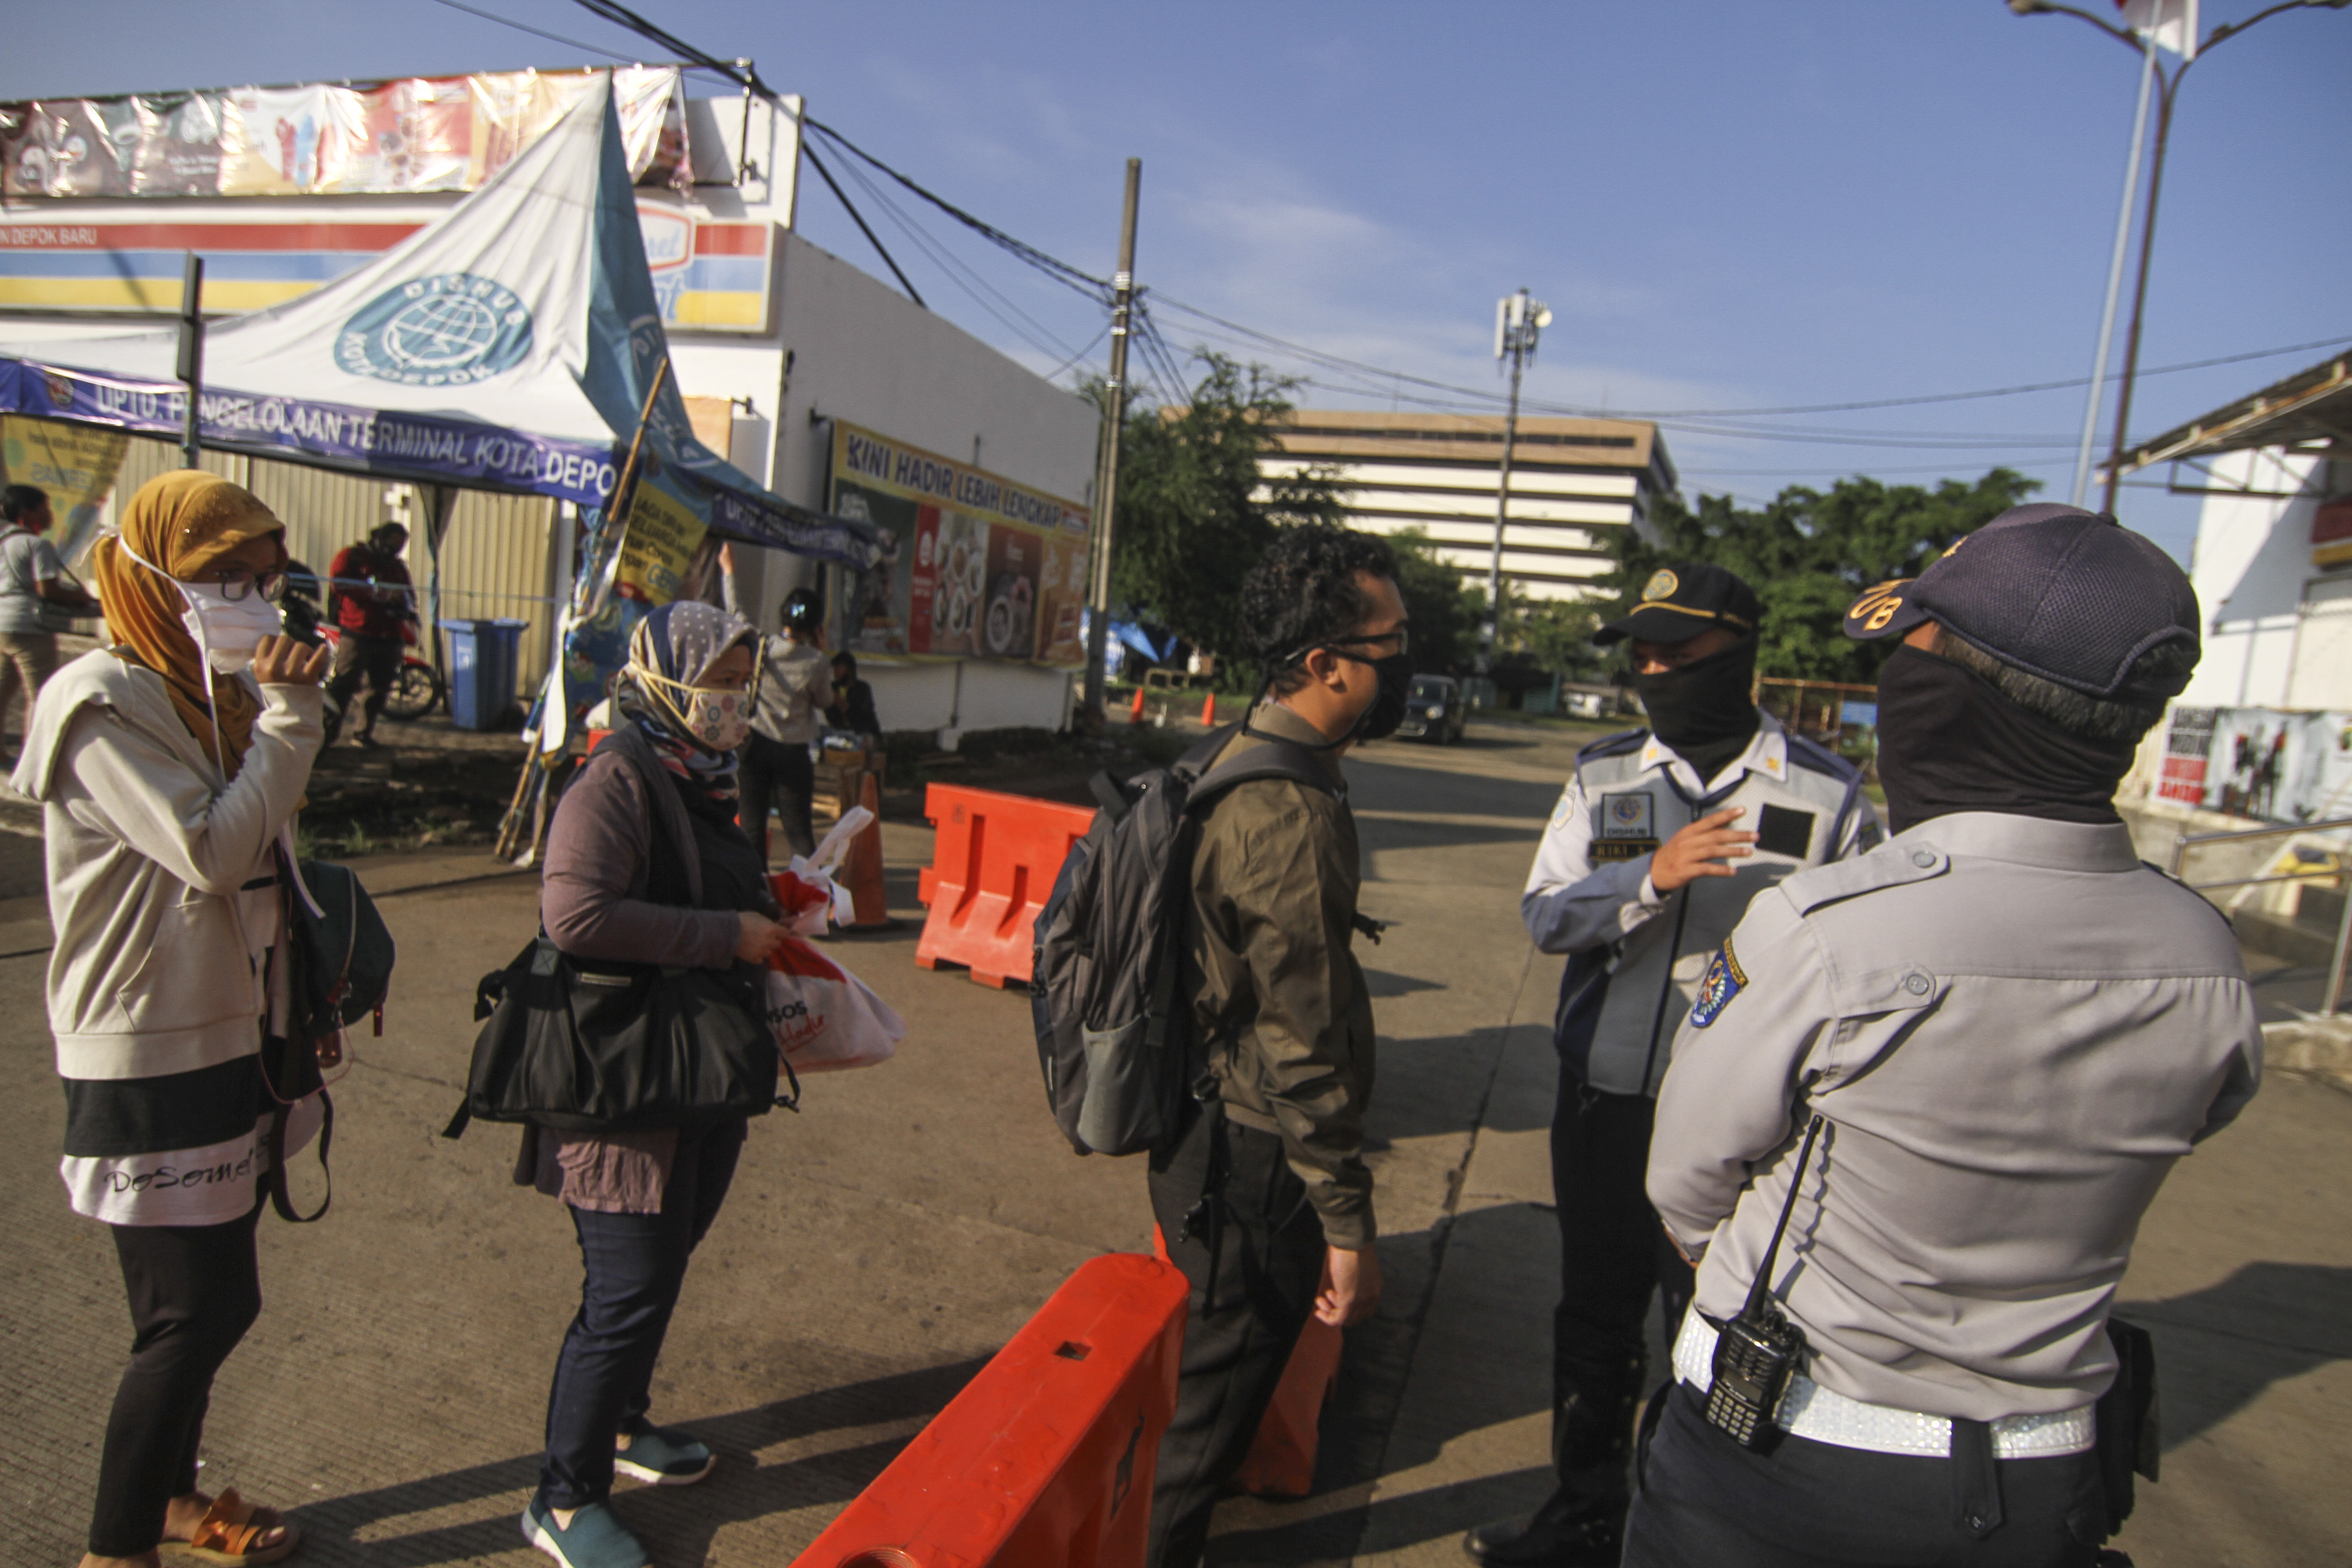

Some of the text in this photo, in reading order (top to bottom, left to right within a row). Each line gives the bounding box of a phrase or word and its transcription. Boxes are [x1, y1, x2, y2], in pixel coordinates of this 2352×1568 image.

[12, 227, 58, 245] DEPOK
[59, 226, 96, 245] BARU
[403, 273, 526, 326] DISHUB
[168, 390, 343, 444] PNGELOLAAN
[347, 414, 469, 465] TERMINAL
[475, 435, 539, 477] KOTA
[546, 451, 617, 497] DEPO
[847, 433, 891, 480] KINI
[895, 449, 954, 497] HADIR
[957, 472, 1001, 511] LEBIH
[1003, 488, 1061, 528] LENGKAP
